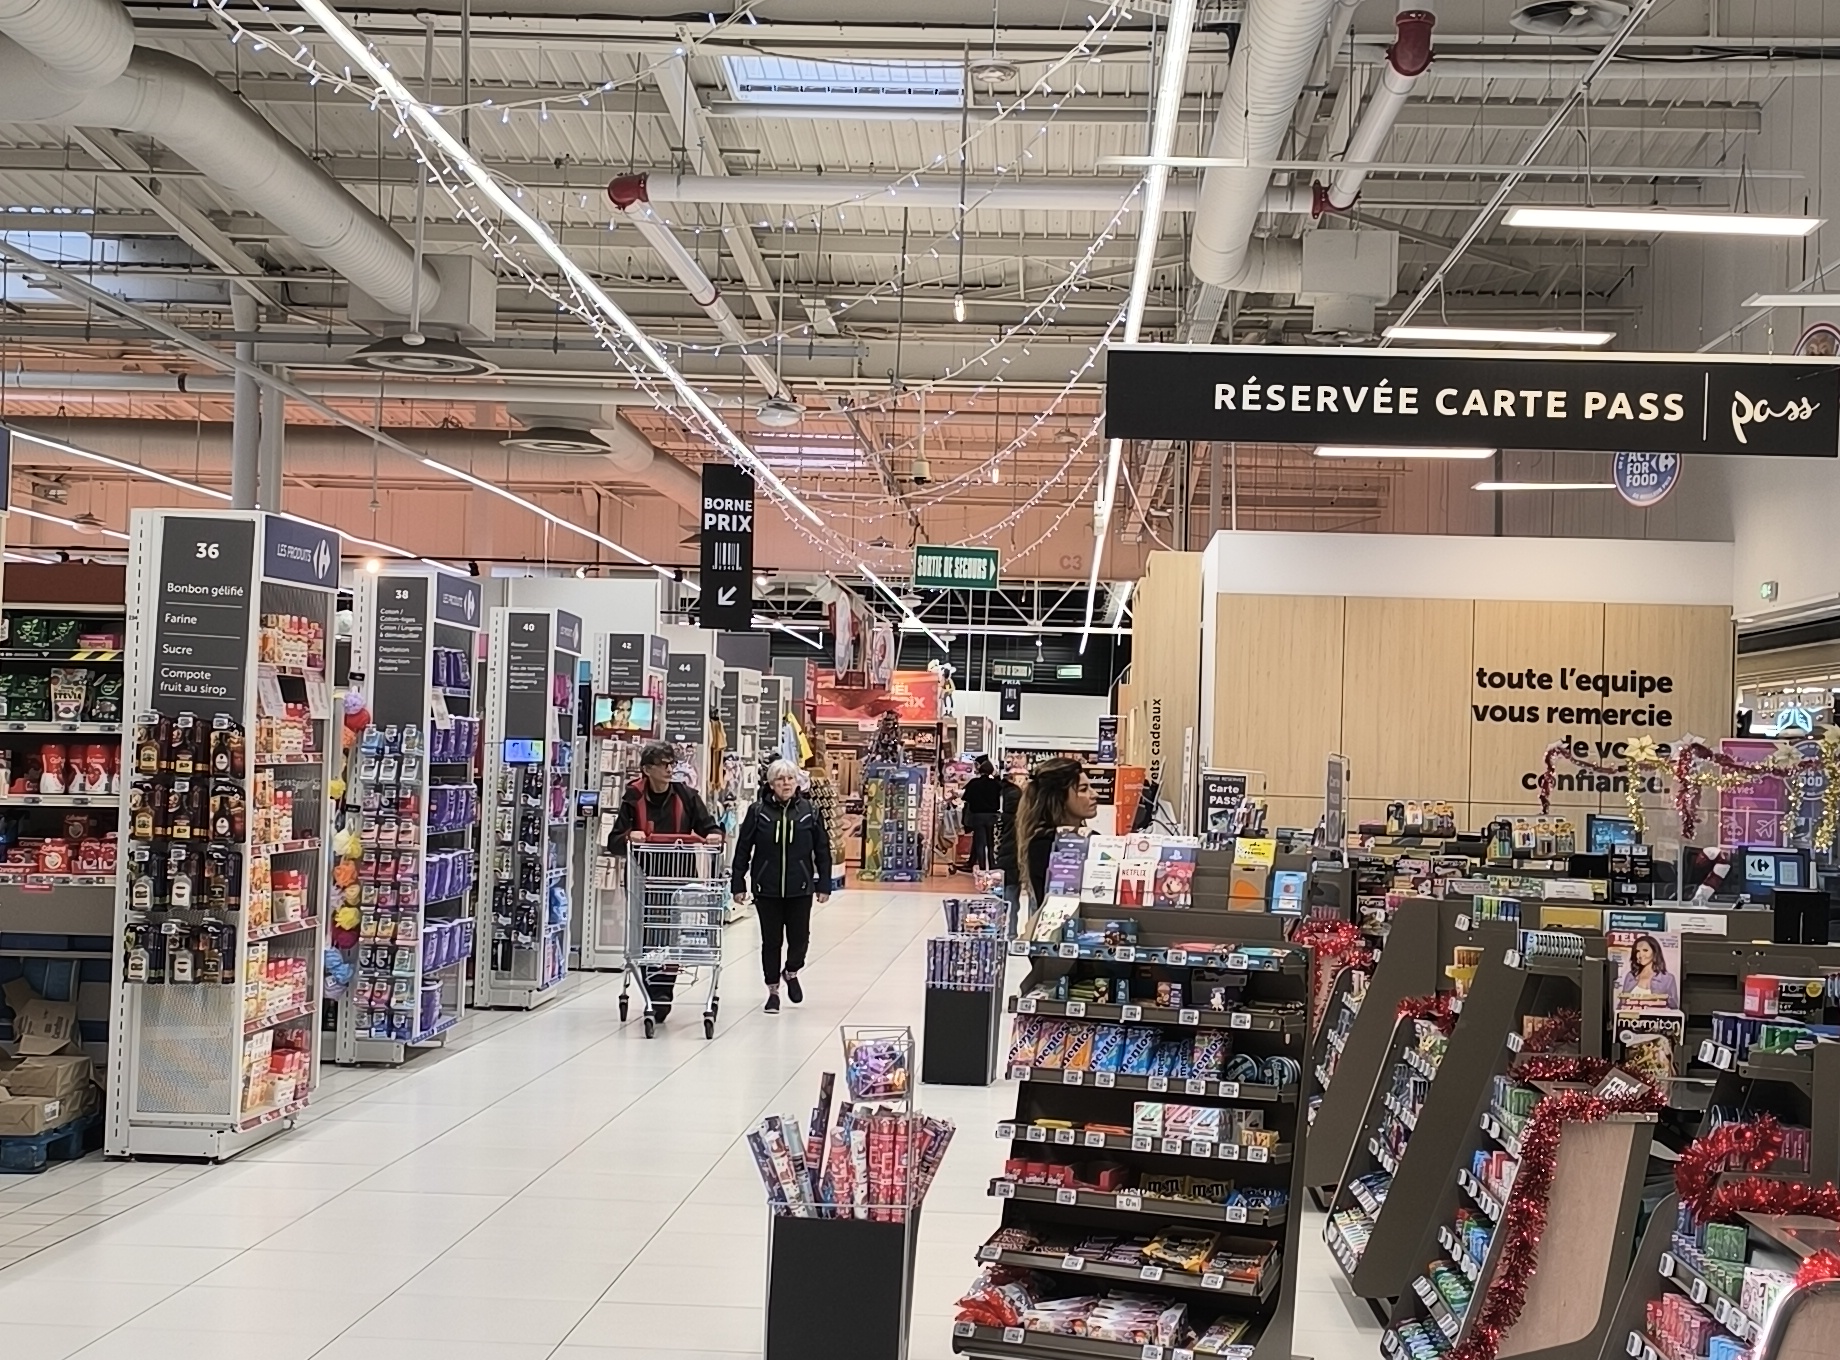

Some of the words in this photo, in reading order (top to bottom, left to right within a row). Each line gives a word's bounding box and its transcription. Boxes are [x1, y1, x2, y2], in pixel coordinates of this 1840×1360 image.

[1213, 375, 1420, 416] RÉSERVÉE
[1435, 387, 1568, 419] CARTE
[1584, 392, 1685, 423] PASS
[1731, 389, 1821, 445] pass
[1626, 462, 1650, 474] FOR
[1625, 473, 1658, 488] FOOD
[704, 497, 753, 512] BORNE
[704, 513, 753, 533] PRIX
[195, 542, 220, 559] 36
[917, 555, 943, 578] SORTIE
[943, 556, 953, 578] DE
[953, 556, 988, 580] SECOURS
[1059, 555, 1083, 571] C3
[167, 582, 209, 595] Bonbon
[211, 584, 244, 597] gélifié
[395, 589, 409, 599] 38
[164, 613, 198, 625] Farine
[523, 623, 535, 632] 40
[162, 643, 193, 655] Sucre
[160, 668, 211, 682] Compote
[678, 663, 691, 672] 44
[160, 681, 182, 693] fruit
[184, 684, 198, 693] au
[200, 682, 227, 696] sirop
[1475, 667, 1553, 690] toute
[1560, 668, 1674, 698] l'equipe
[1472, 705, 1540, 723] vous
[1547, 704, 1673, 727] remercie
[1150, 699, 1161, 755] cadeaux
[1595, 740, 1672, 760] voe
[1209, 783, 1240, 794] Carte
[1209, 795, 1237, 806] PASS
[1121, 869, 1147, 878] NETFLIX
[1617, 1018, 1681, 1034] marmiton
[1008, 1016, 1044, 1061] mentos
